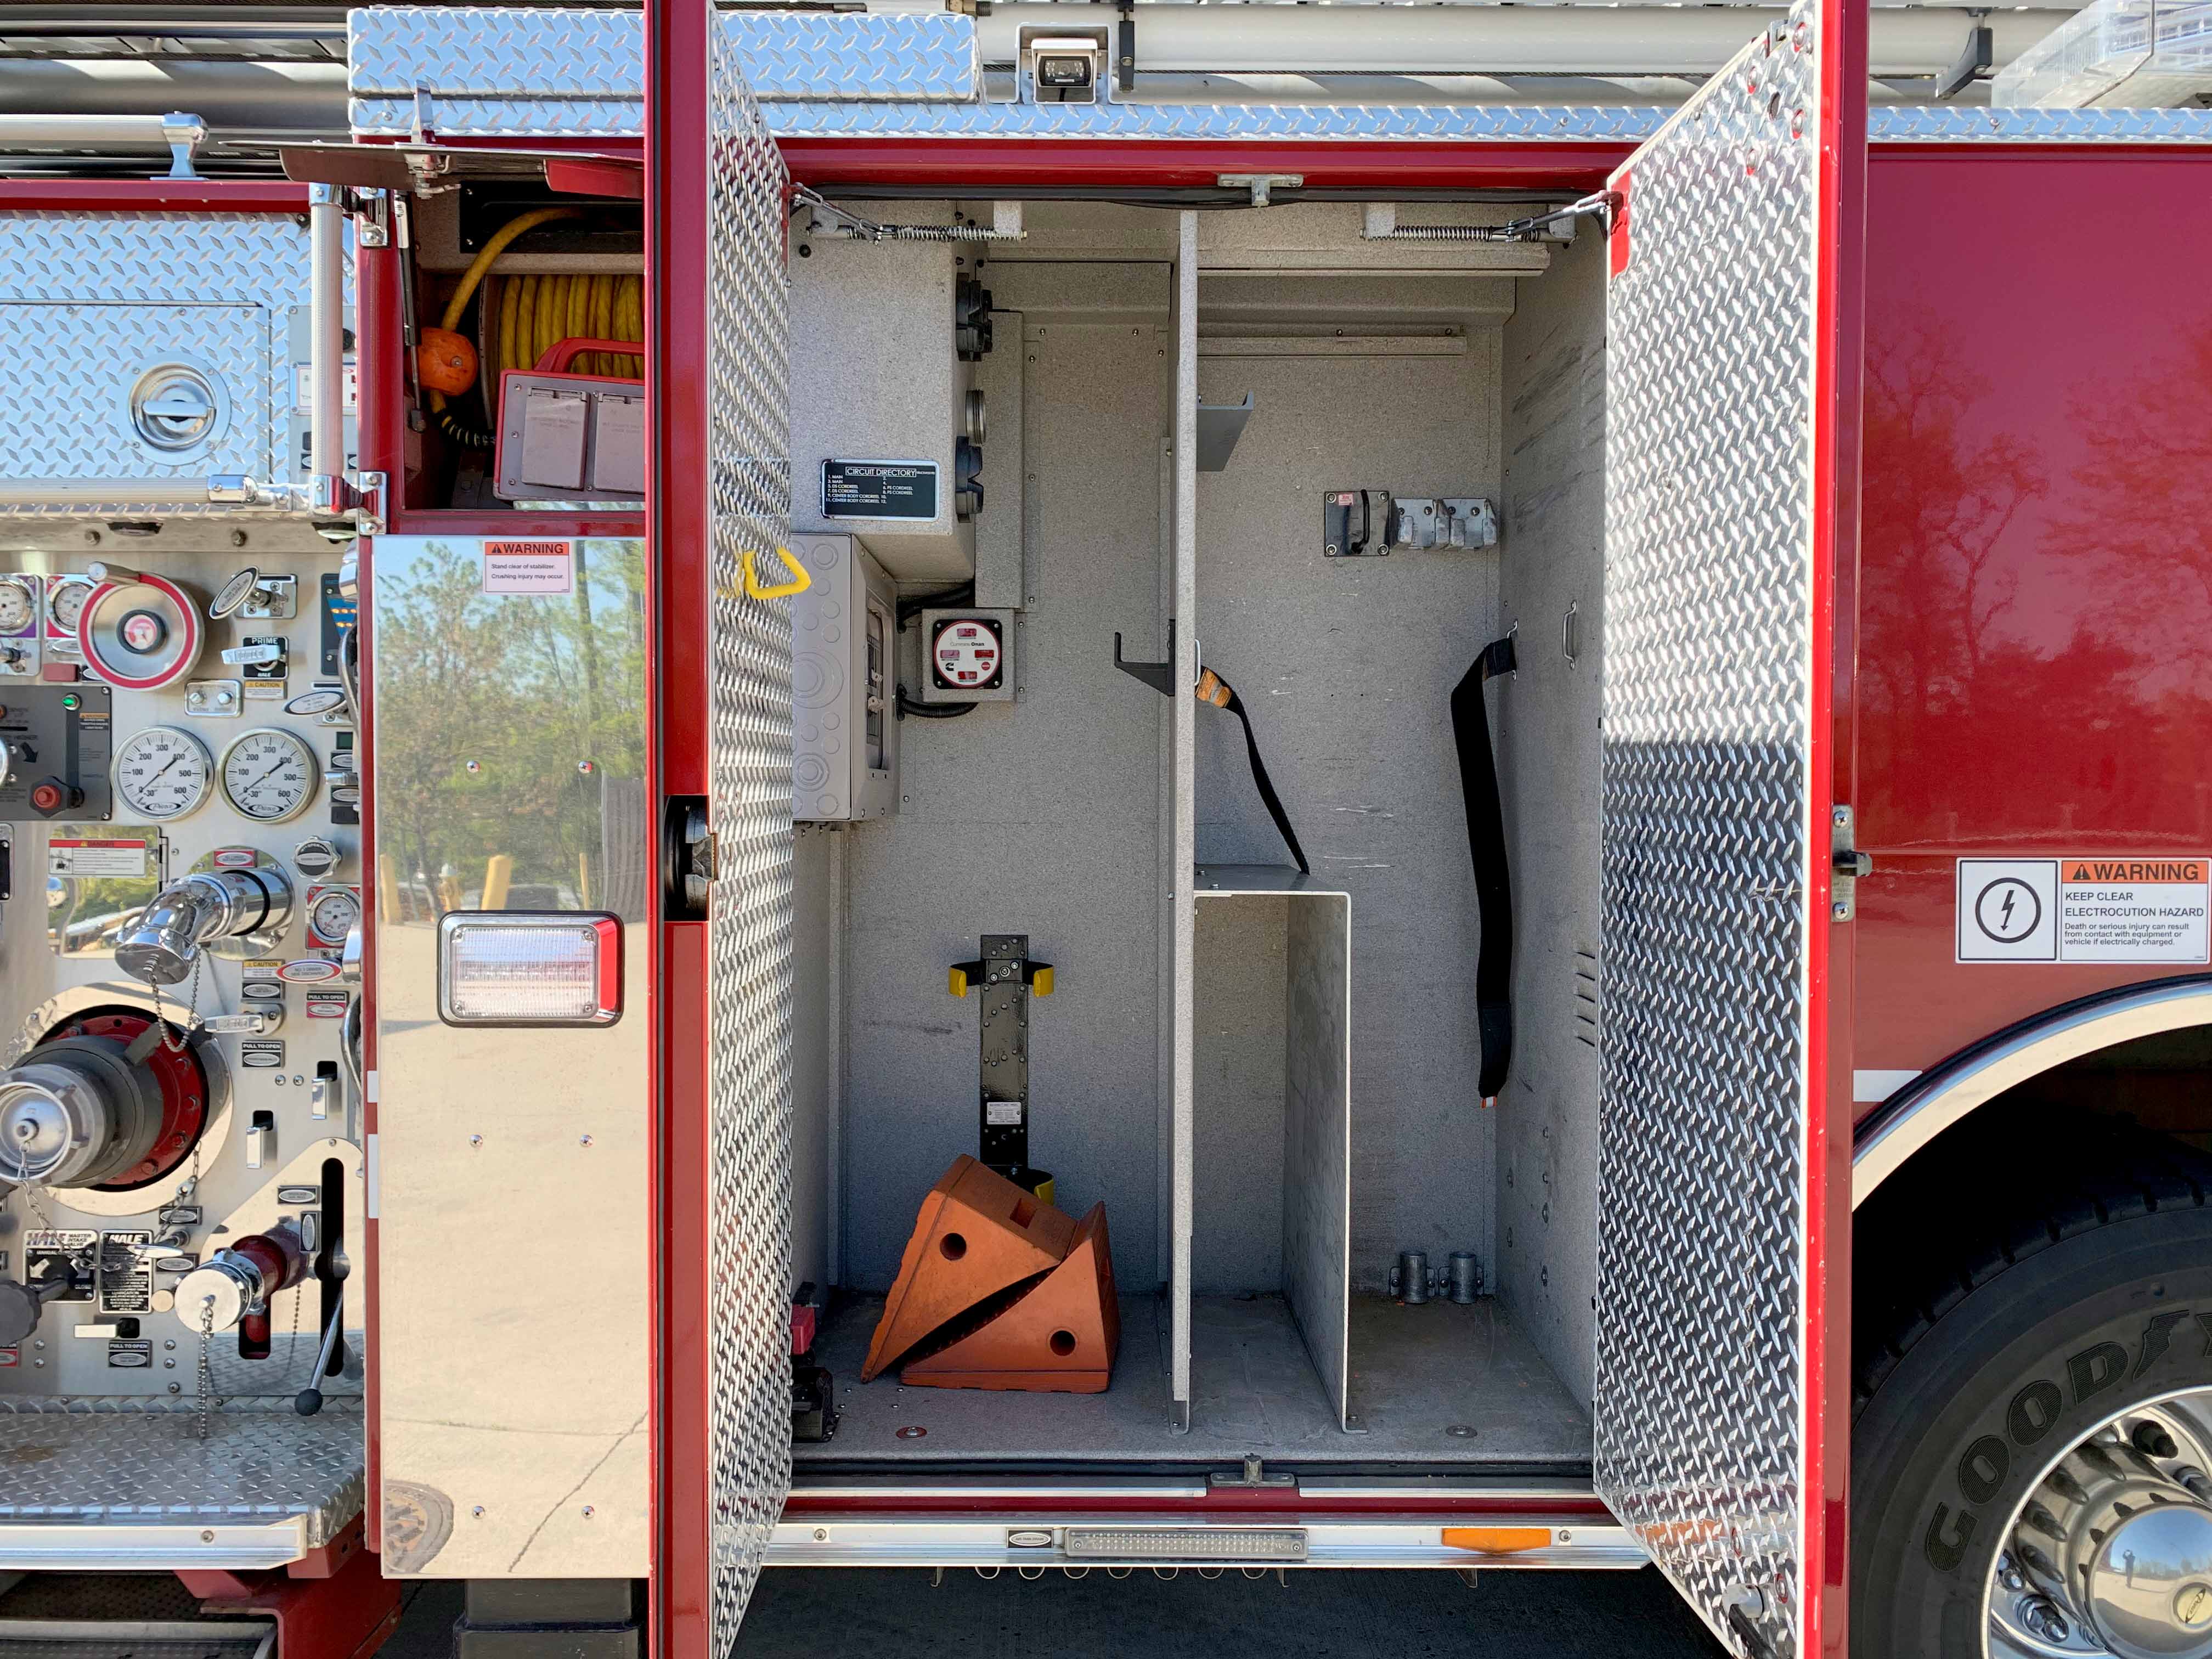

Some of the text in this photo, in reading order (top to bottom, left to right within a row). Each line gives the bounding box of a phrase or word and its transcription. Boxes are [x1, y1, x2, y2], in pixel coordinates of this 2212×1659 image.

[503, 544, 563, 554] WARNING
[2094, 864, 2199, 881] WARNING
[2065, 892, 2134, 901] KEEP CLEAR
[2065, 907, 2204, 917] ELECTROCUTION HAZARD
[2129, 923, 2150, 932] injury
[2132, 931, 2172, 939] equipment
[2100, 938, 2141, 947] electrically
[2142, 939, 2175, 947] charged.
[110, 1234, 143, 1244] HALE
